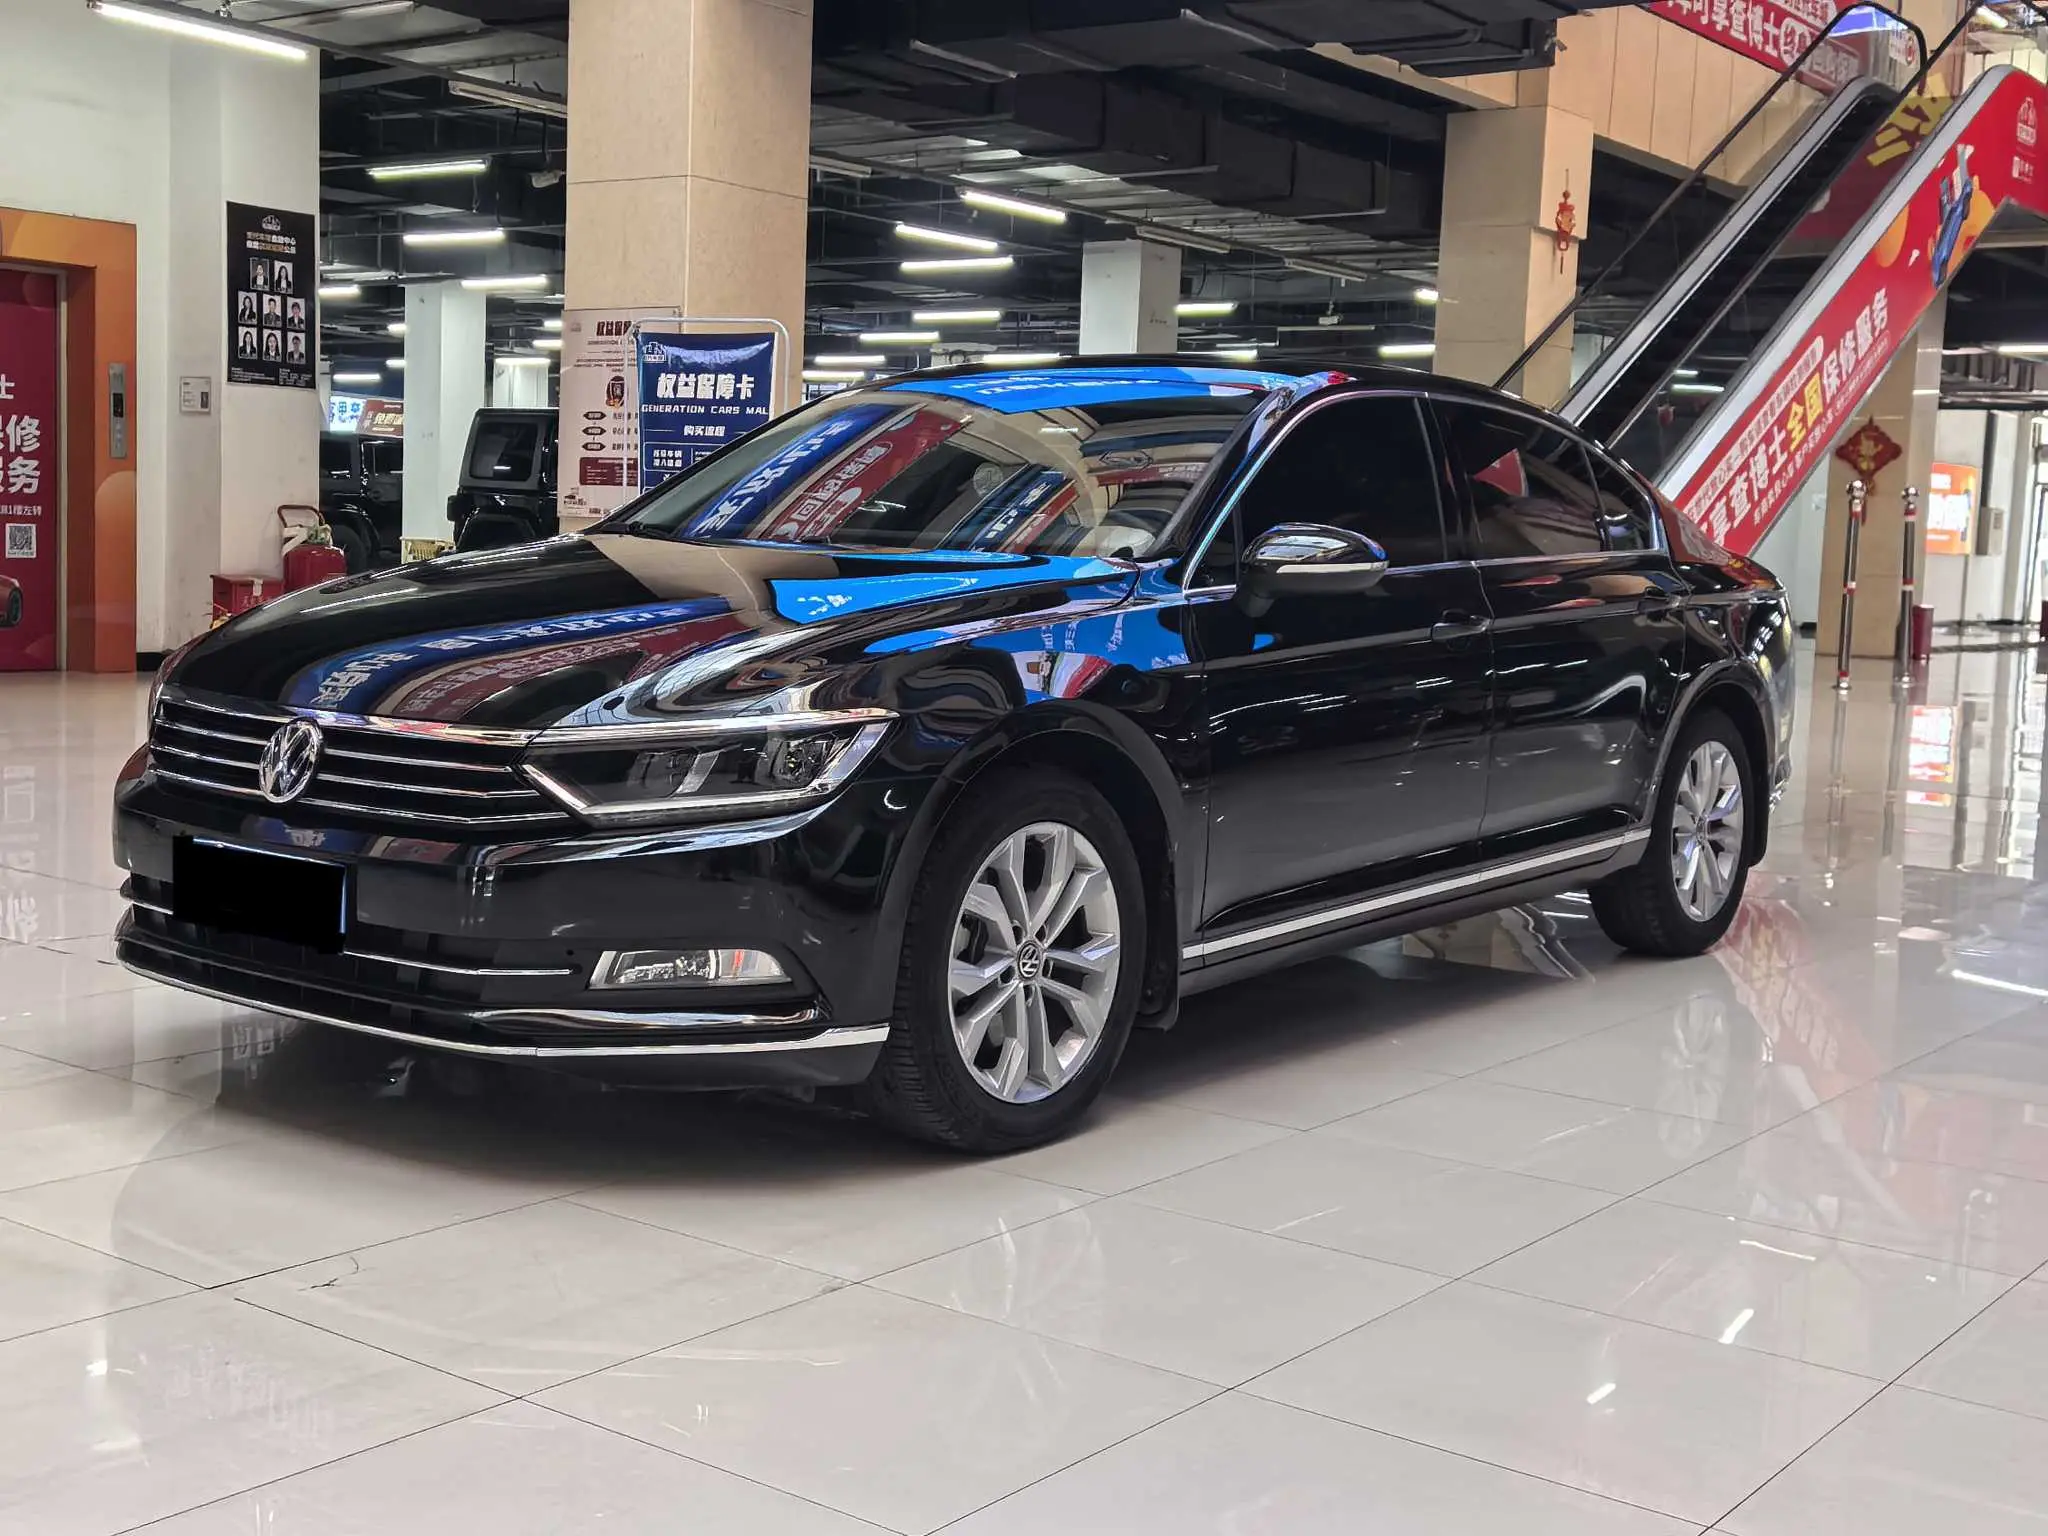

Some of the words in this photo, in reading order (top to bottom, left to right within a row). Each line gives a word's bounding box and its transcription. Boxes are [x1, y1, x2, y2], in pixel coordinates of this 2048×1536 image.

[657, 373, 754, 400] 权益保障卡
[641, 404, 705, 414] GENERATION
[710, 406, 740, 414] CARS
[683, 425, 726, 437] 购买流程
